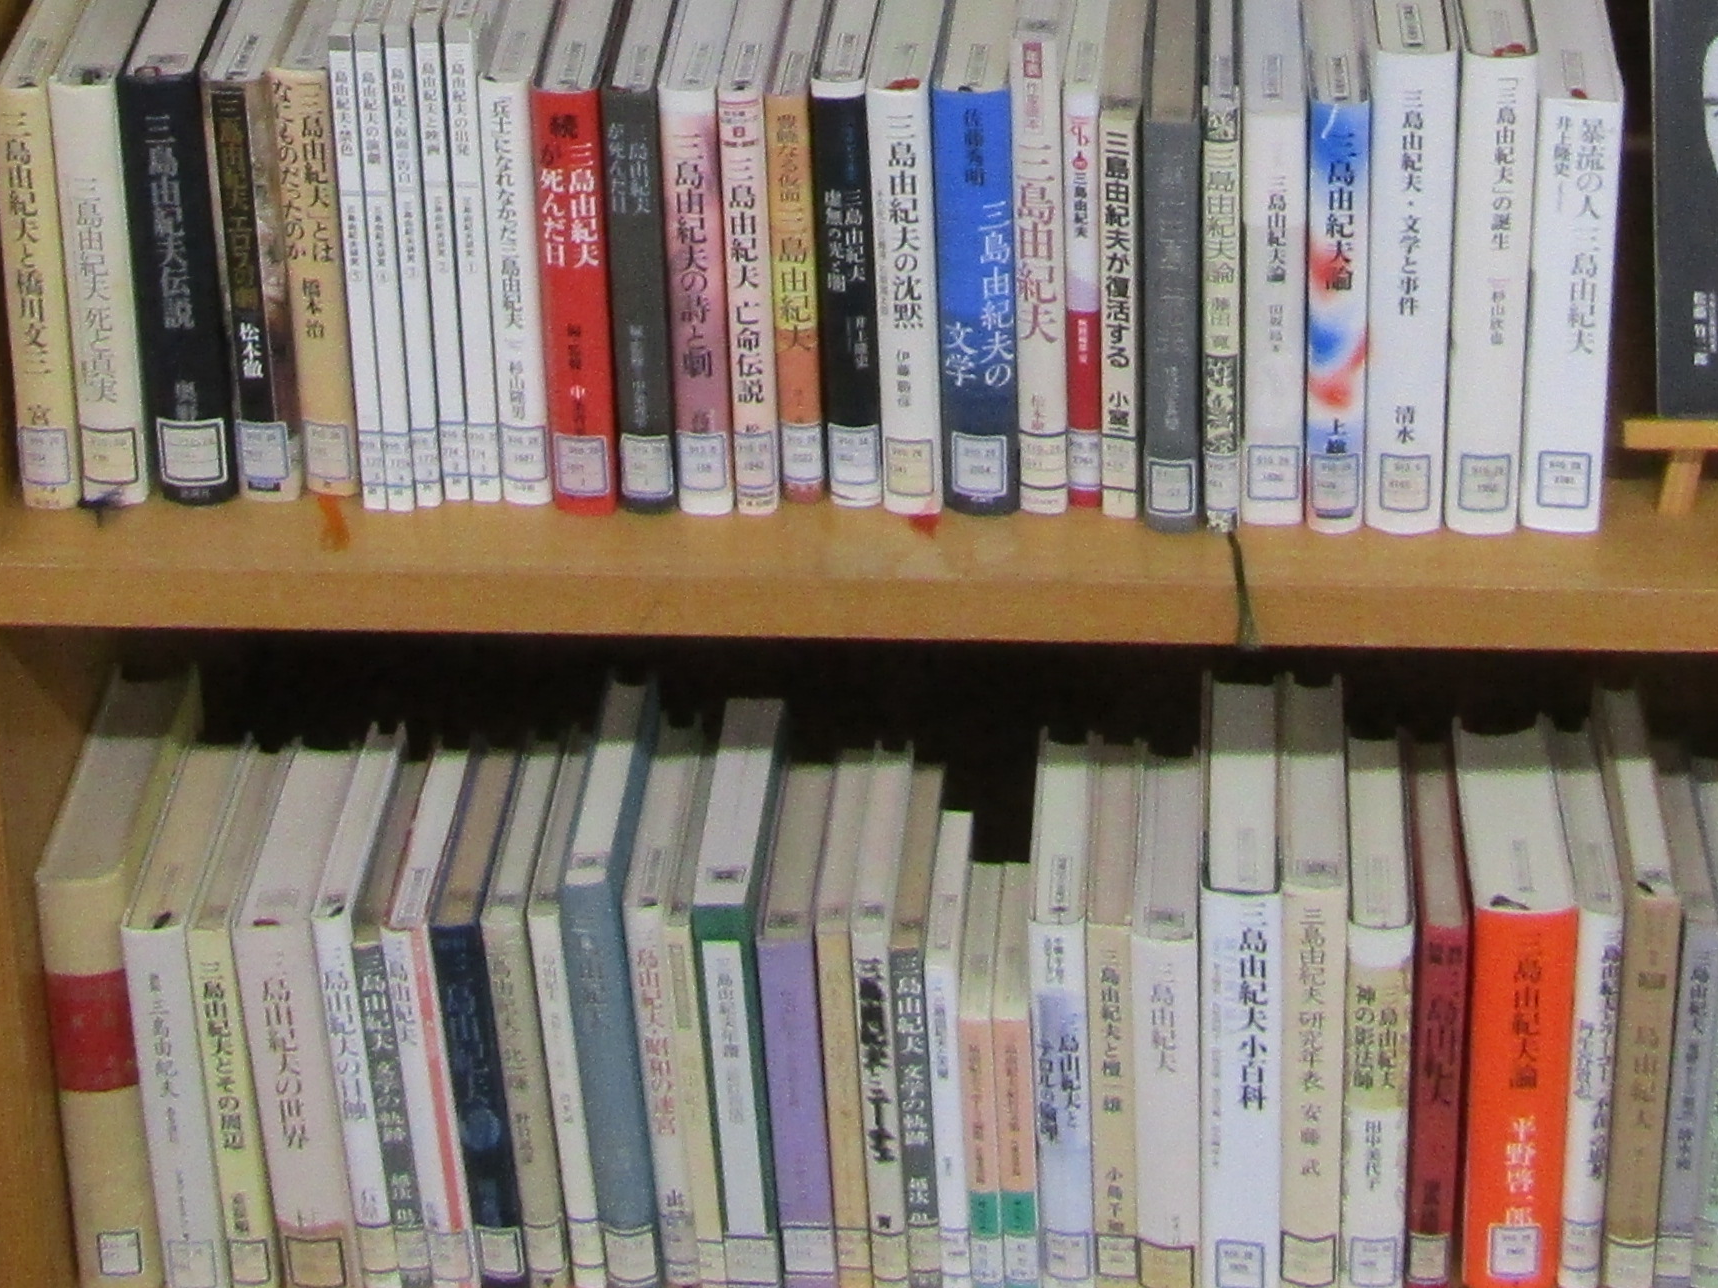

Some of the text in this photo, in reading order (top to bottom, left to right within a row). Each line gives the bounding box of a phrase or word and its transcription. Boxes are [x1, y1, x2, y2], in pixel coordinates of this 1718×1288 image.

[1, 111, 50, 377] 三島由紀夫と橋川文三
[144, 114, 196, 329] 三島由紀夫伝説
[272, 79, 309, 262] なにものだったのか
[299, 81, 333, 263] 「三島由紀夫」とは
[540, 140, 567, 267] が死んだ日
[569, 143, 600, 267] 三島由紀夫
[843, 188, 866, 282] 三島由紀夫
[885, 113, 924, 330] 三島由紀夫の沈黙
[1016, 143, 1058, 343] 三島由紀夫
[1073, 172, 1089, 239] 三島由紀夫
[1205, 148, 1236, 285] 三島由紀夫論
[1266, 174, 1288, 285] 三島由紀夫論
[1324, 131, 1356, 292] 三島由紀夫論
[1489, 76, 1520, 253] 「三島由紀夫」の誕生
[675, 130, 713, 379] 三島由紀夫の詩と劇
[777, 206, 811, 351] 三島由紀夫
[980, 200, 1014, 389] 三島由紀夫の
[1104, 130, 1131, 369] 三島由紀夫が復活する
[1395, 88, 1425, 445] 三島由紀夫・文学と事件 清水
[944, 322, 979, 388] 文学
[1151, 962, 1177, 1075] 三島由紀夫
[1509, 931, 1543, 1091] 三島由紀夫論
